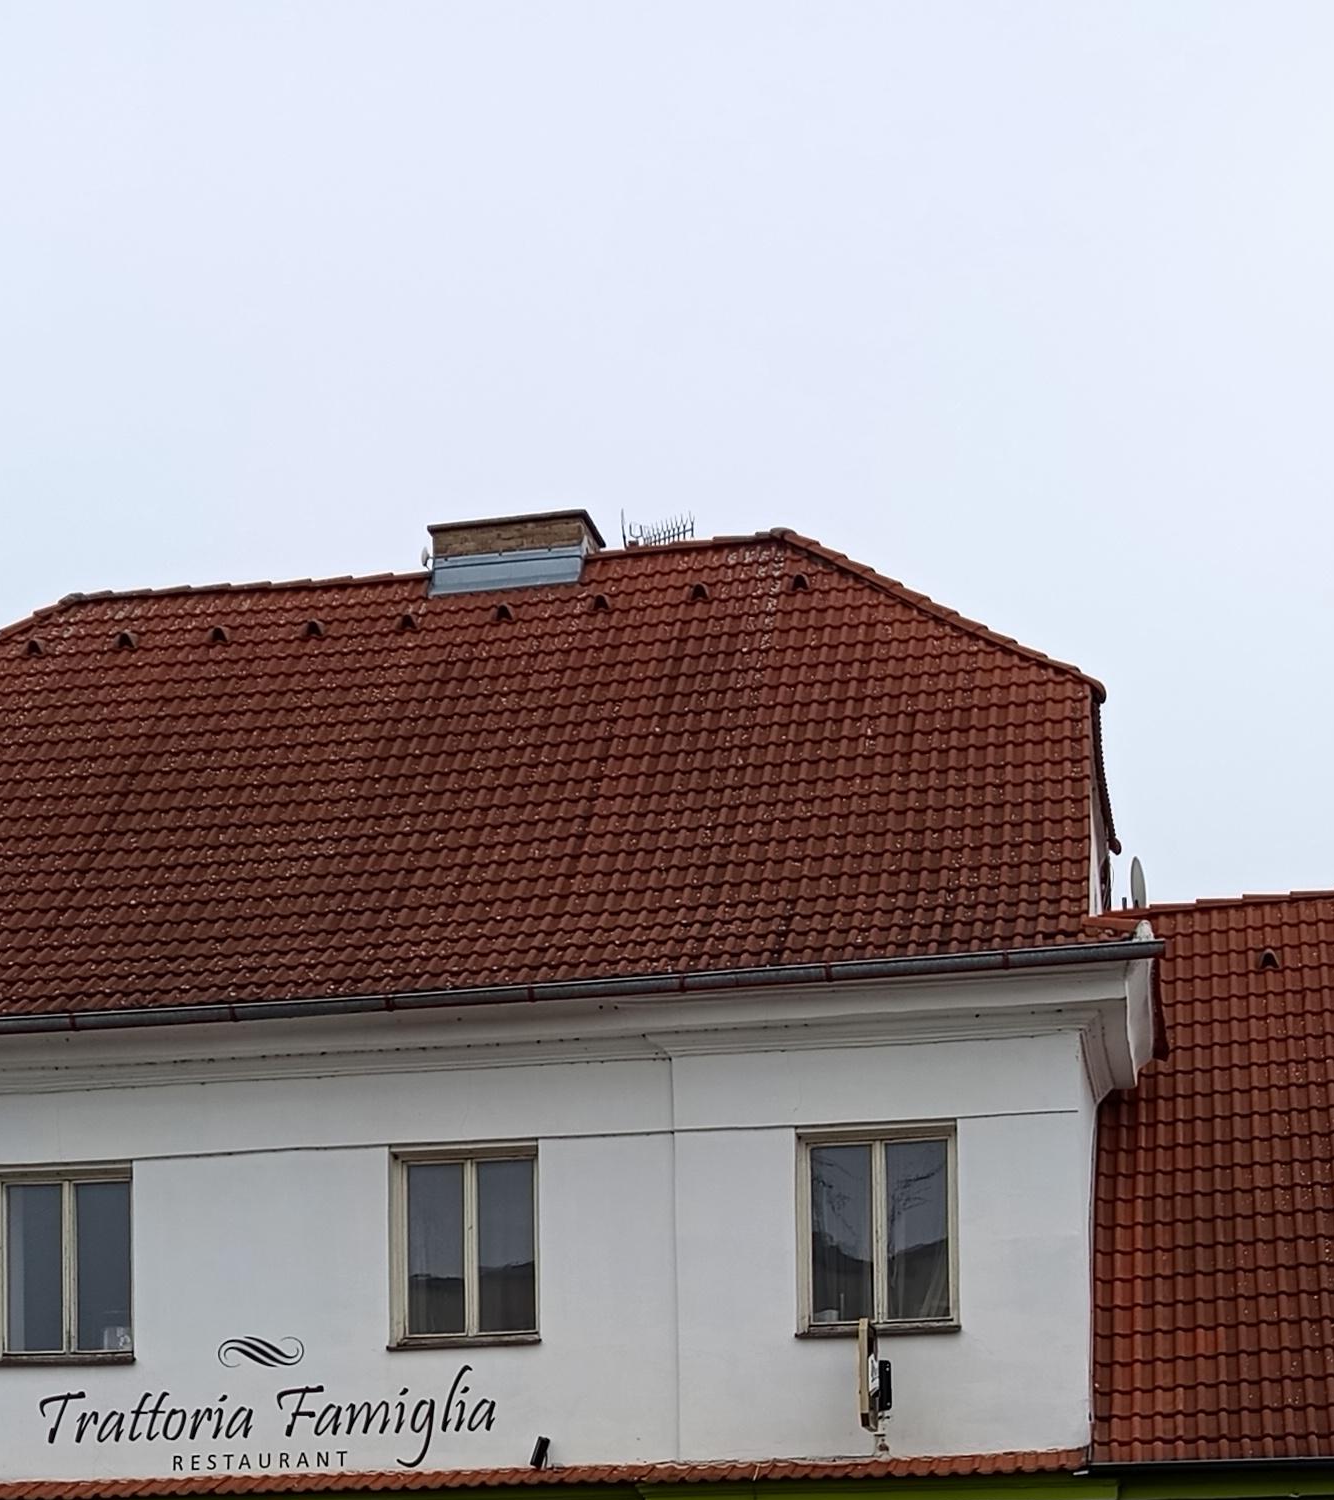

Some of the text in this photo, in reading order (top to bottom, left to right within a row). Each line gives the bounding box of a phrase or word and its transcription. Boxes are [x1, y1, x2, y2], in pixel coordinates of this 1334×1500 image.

[39, 1365, 496, 1468] Trattoria Famiglia
[172, 1450, 349, 1472] RESTAURANT
